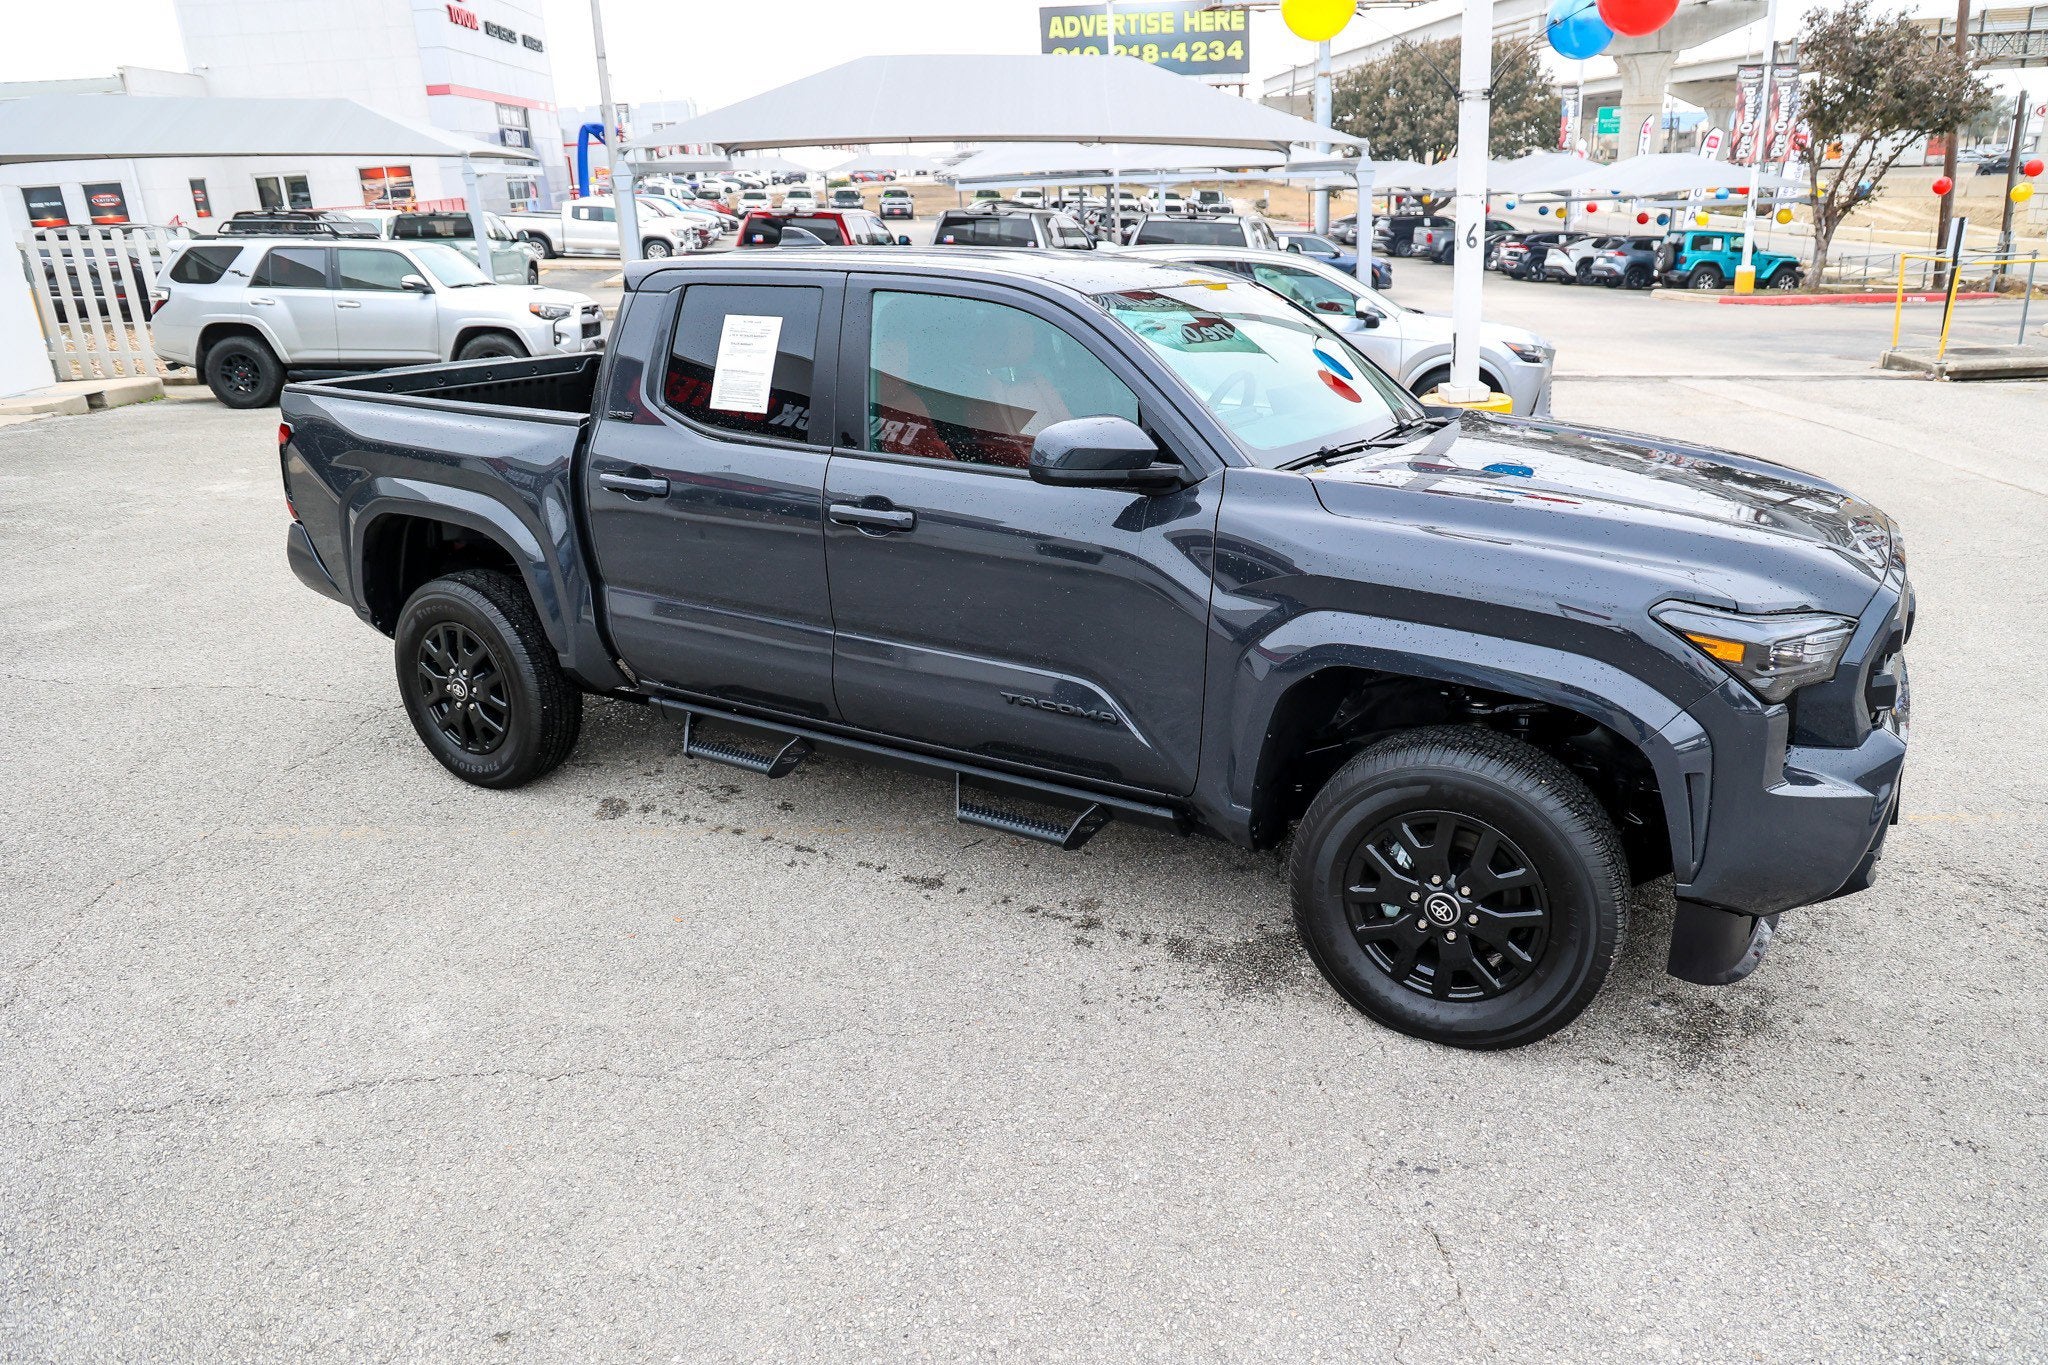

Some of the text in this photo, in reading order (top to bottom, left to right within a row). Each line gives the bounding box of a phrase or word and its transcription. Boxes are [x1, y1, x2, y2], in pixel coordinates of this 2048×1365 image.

[446, 4, 479, 31] TOYOTA
[1049, 10, 1245, 39] ADVERTISE HERE
[1051, 40, 1244, 63] 218-4234
[1466, 222, 1478, 249] 6
[999, 690, 1118, 726] TACOMA
